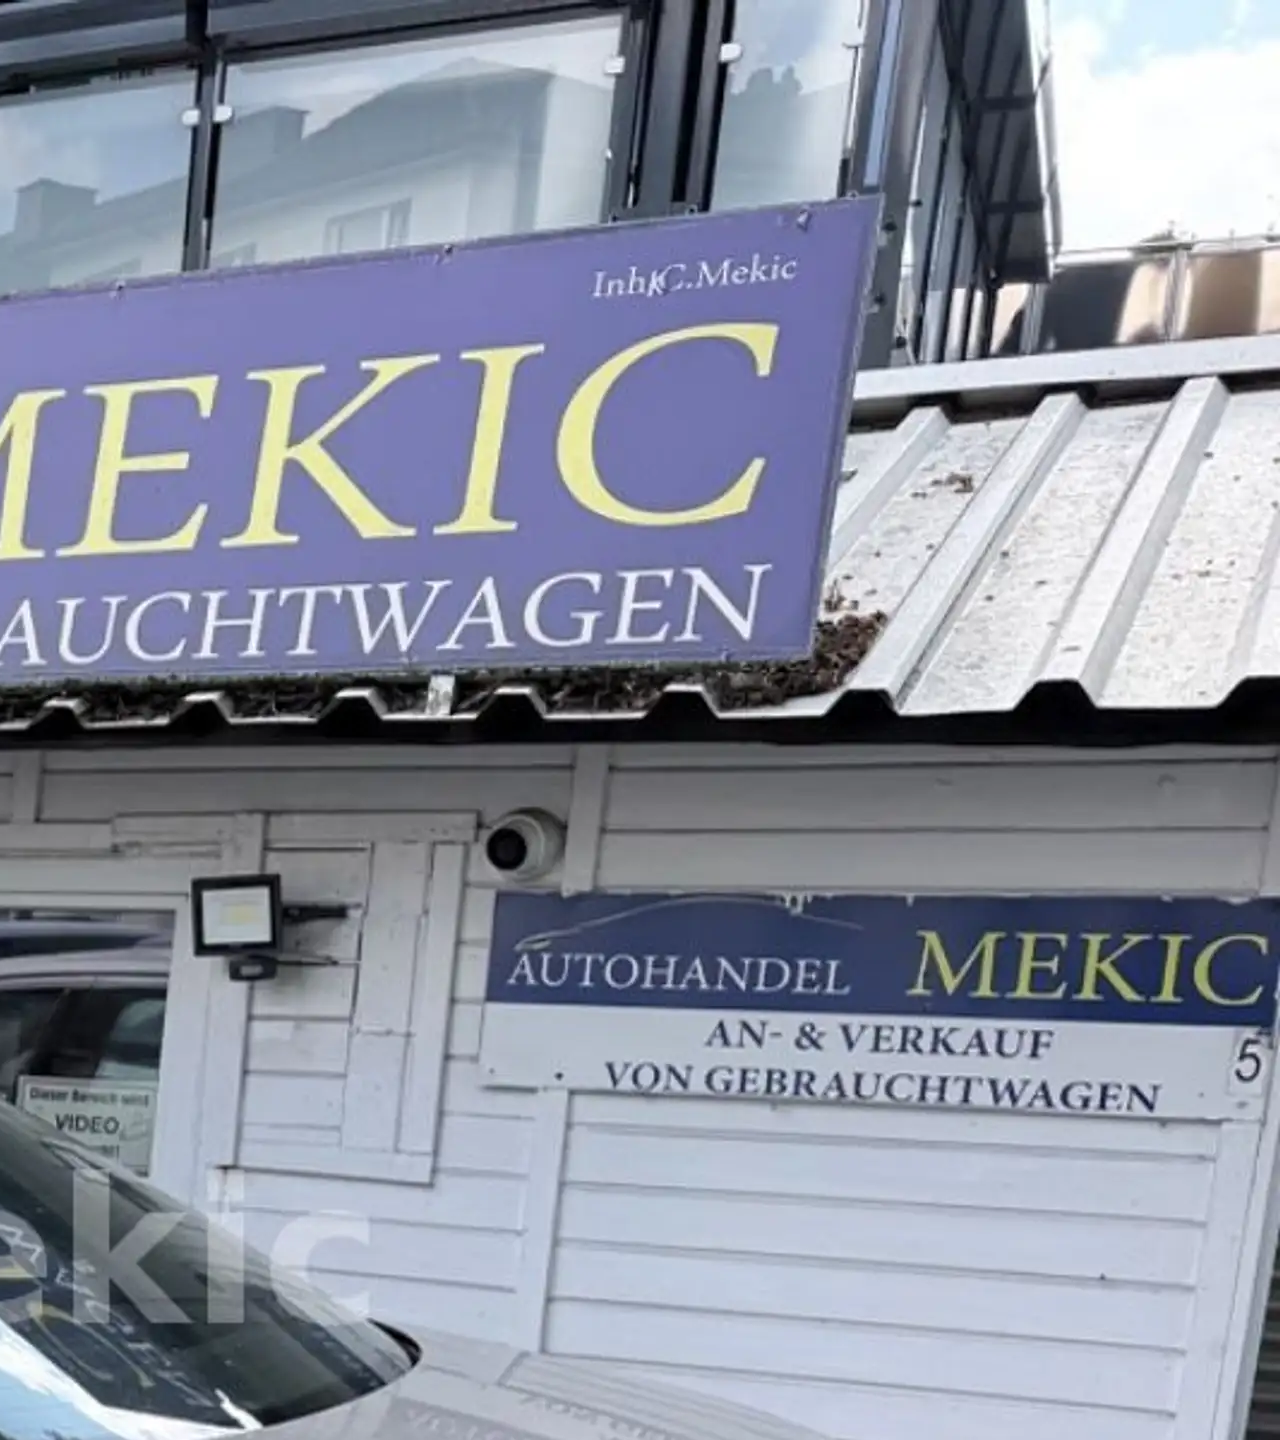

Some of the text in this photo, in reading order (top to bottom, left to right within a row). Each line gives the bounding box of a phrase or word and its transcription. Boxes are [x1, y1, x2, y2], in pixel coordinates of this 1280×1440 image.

[507, 929, 1266, 1007] AUTOHANDEL MEKIC
[704, 1020, 1055, 1060] AN- & VERKAUF
[1234, 1037, 1262, 1084] 5
[604, 1061, 1162, 1114] VON GEBRAUCHTWAGEN
[54, 1113, 120, 1135] VIDEO
